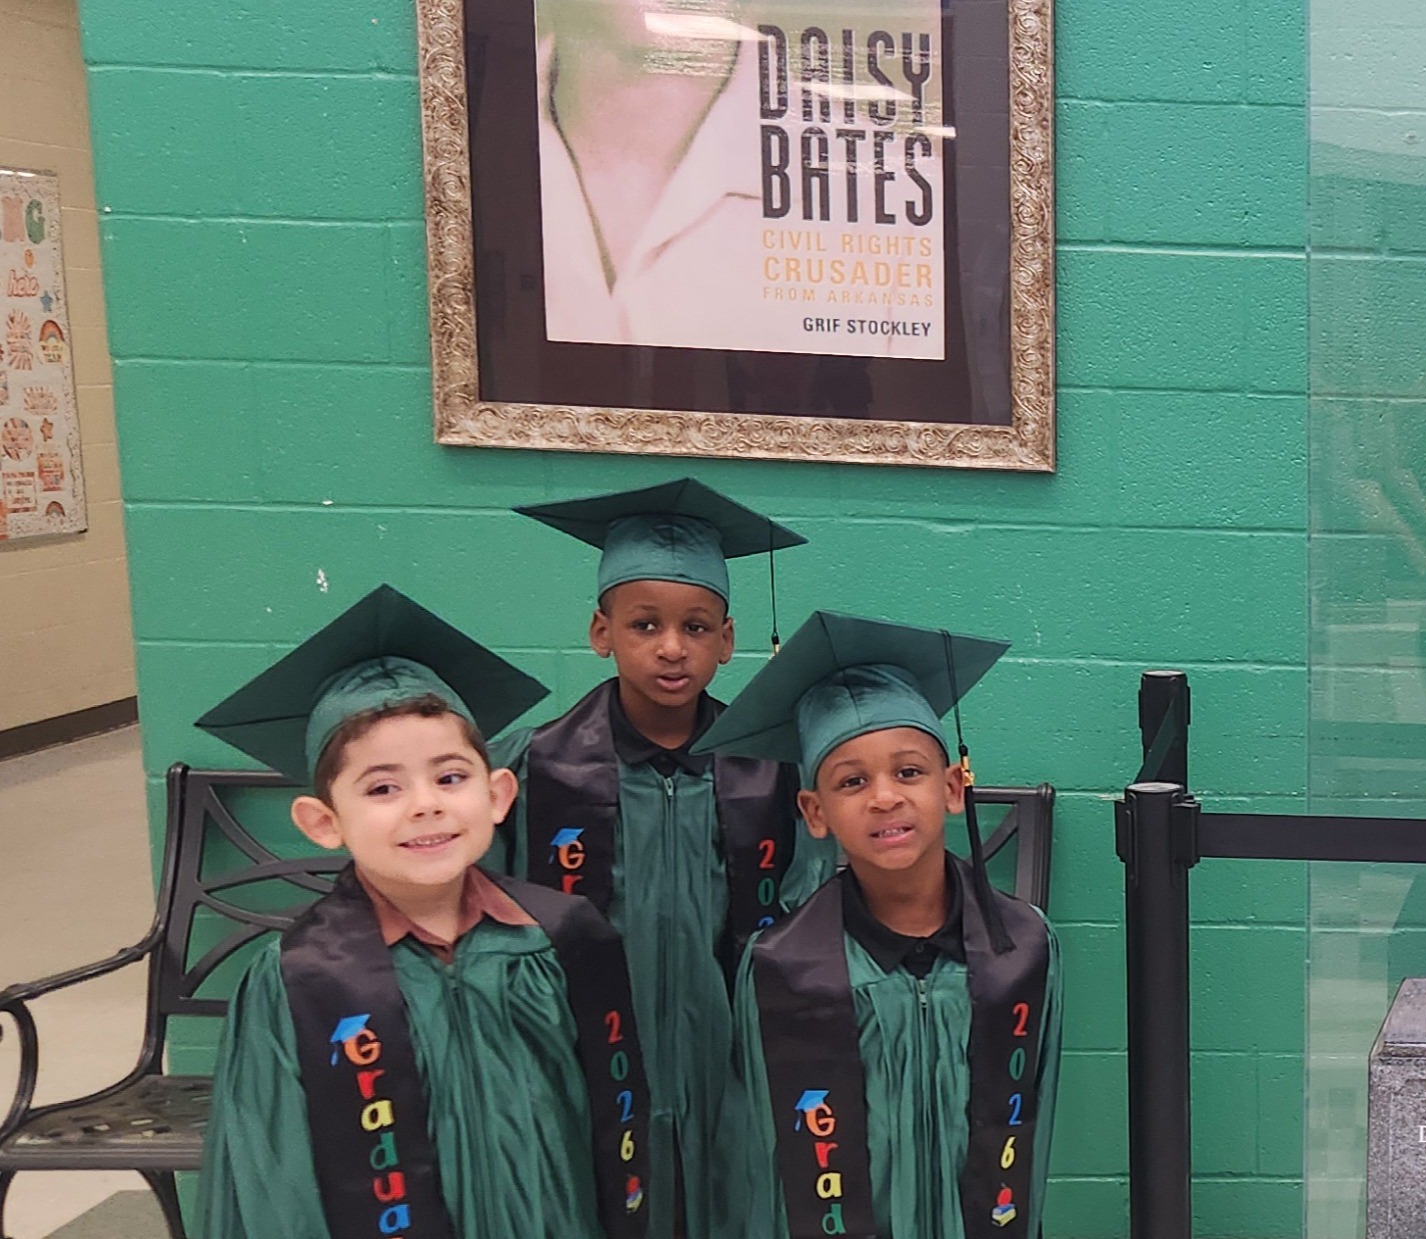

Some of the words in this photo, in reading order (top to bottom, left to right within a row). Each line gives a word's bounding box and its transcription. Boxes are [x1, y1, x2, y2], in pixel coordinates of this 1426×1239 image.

[757, 24, 931, 126] DAISY
[760, 124, 933, 227] BATES
[762, 229, 827, 252] CIVIL
[841, 233, 932, 257] RIGHTS
[763, 256, 933, 289] CRUSADER
[763, 286, 816, 302] FROM
[828, 289, 933, 307] ARKANSAS
[803, 317, 841, 333] GRIF
[847, 319, 931, 337] STOCKLEY
[343, 1028, 412, 1239] Gradua
[604, 1010, 635, 1162] 2026
[1000, 1002, 1029, 1169] 2026
